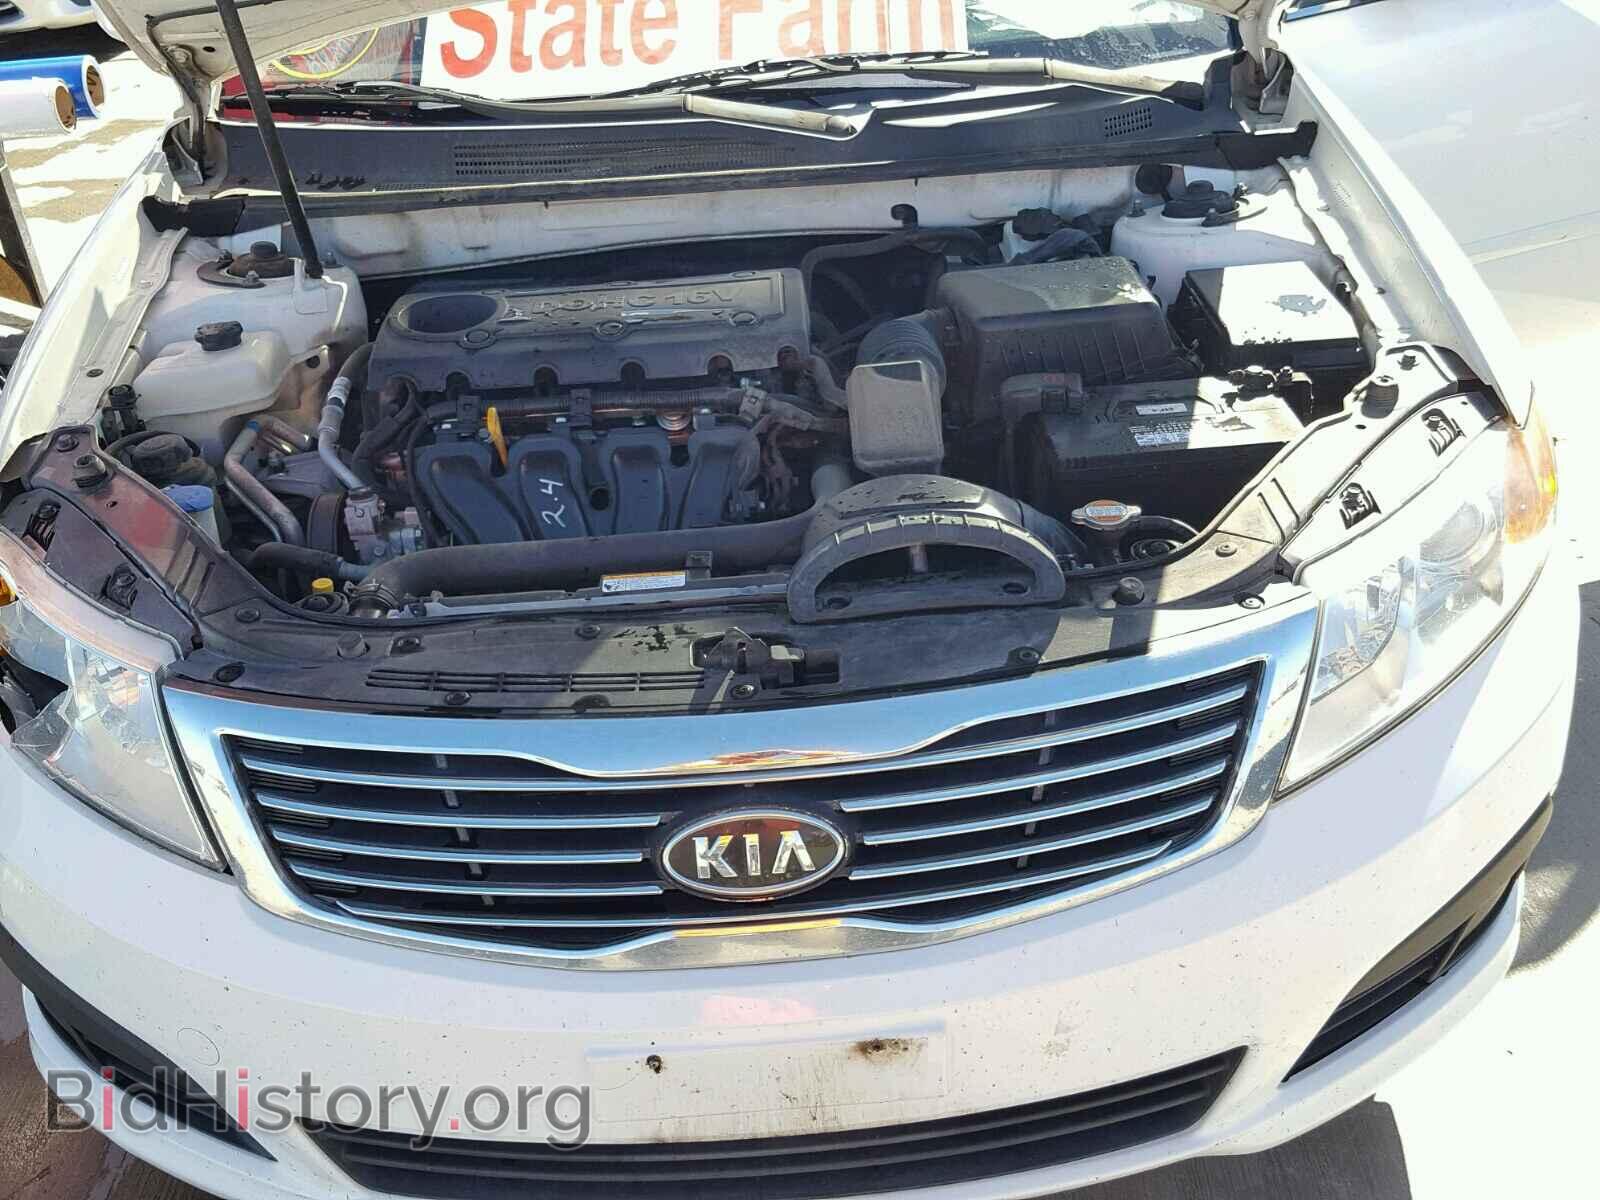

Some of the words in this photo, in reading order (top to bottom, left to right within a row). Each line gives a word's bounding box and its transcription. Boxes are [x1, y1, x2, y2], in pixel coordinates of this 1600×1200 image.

[440, 0, 677, 79] State
[665, 284, 743, 306] 16V
[538, 478, 566, 528] 2.4
[691, 830, 816, 879] KIA
